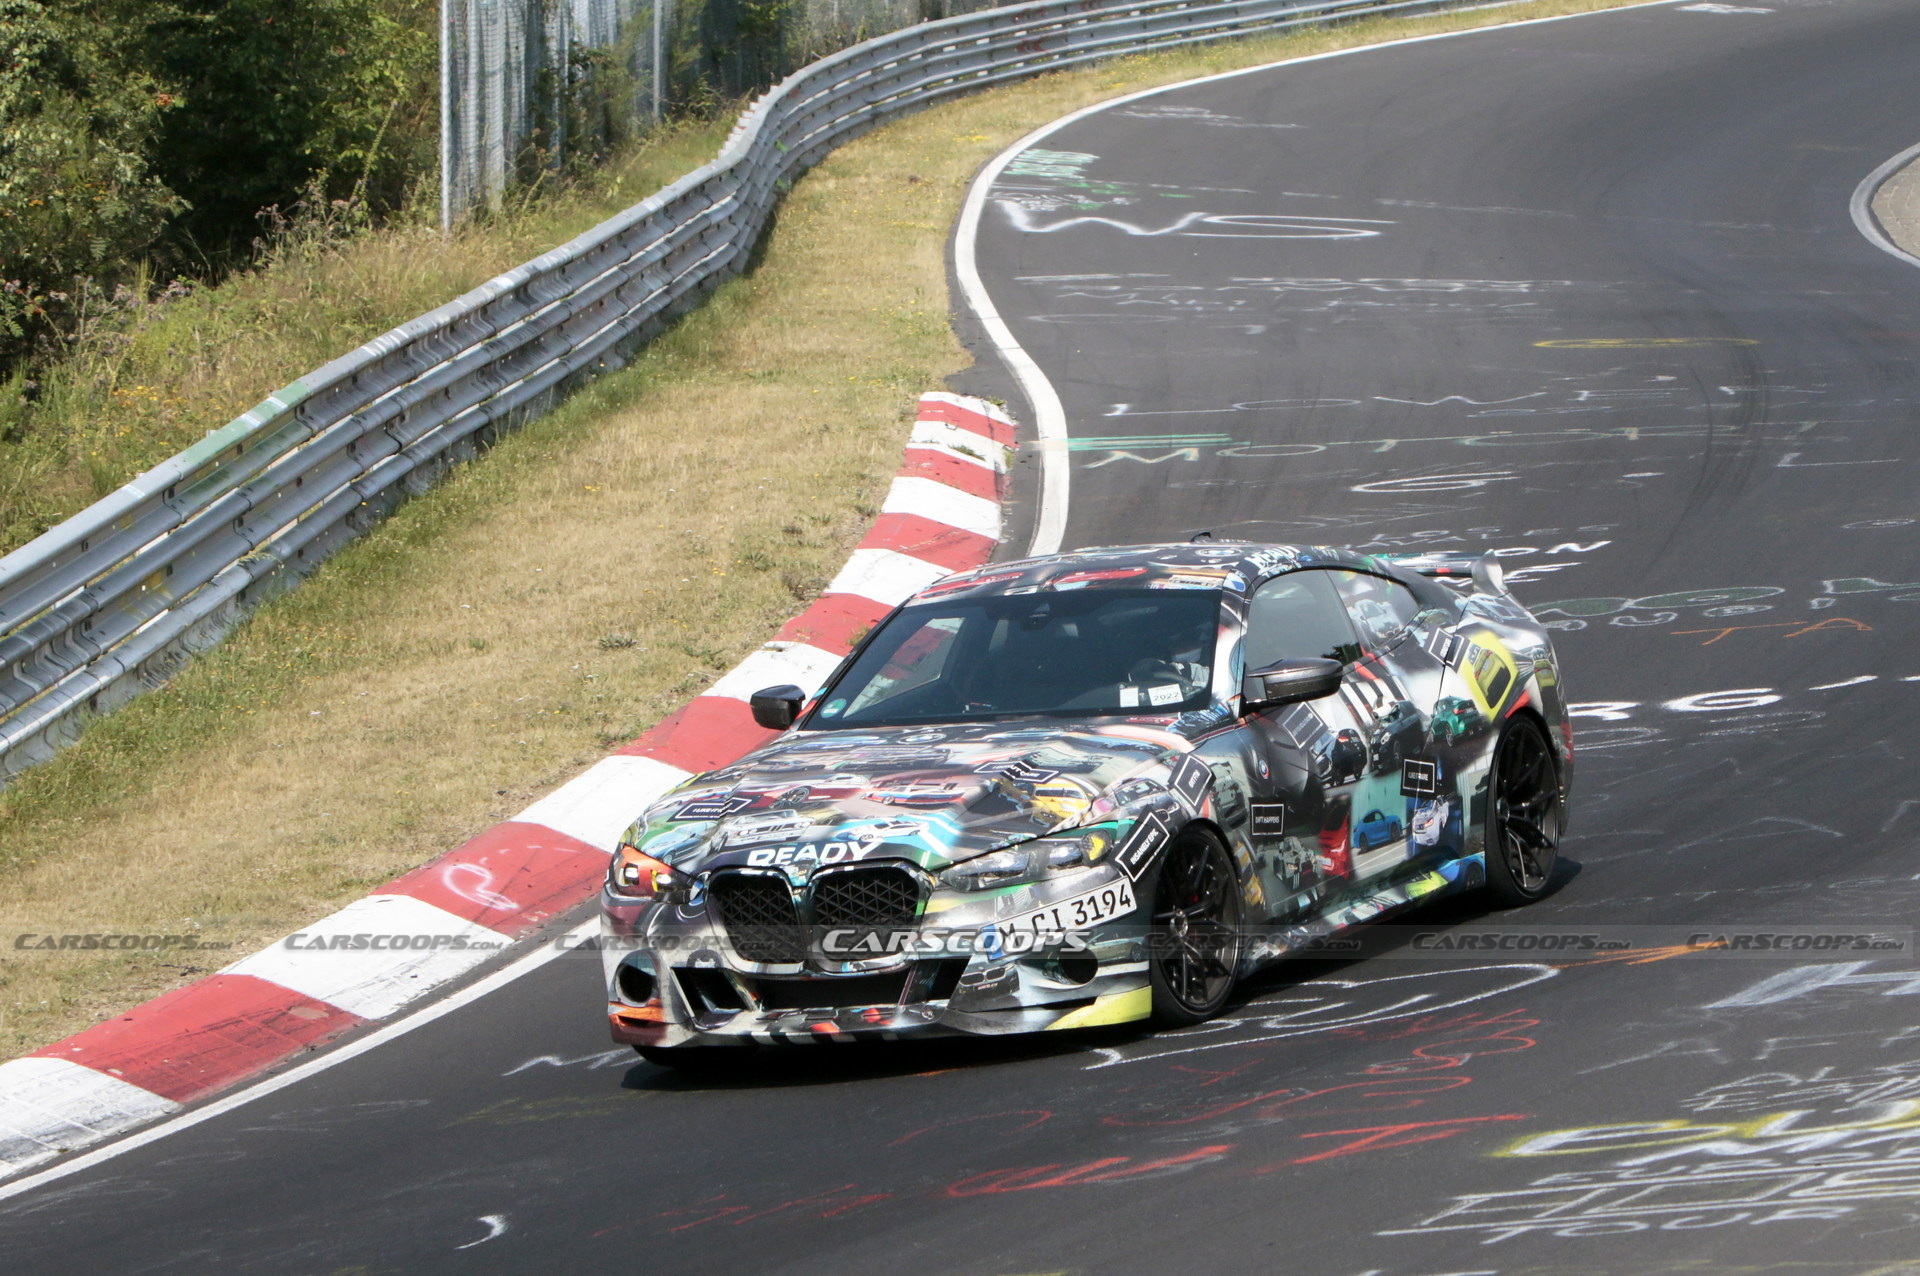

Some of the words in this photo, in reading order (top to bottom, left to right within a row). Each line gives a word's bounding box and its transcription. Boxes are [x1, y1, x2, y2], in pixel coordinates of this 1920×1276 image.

[746, 838, 885, 867] READY
[1130, 836, 1152, 865] INSANELY
[1071, 884, 1131, 926] 3194
